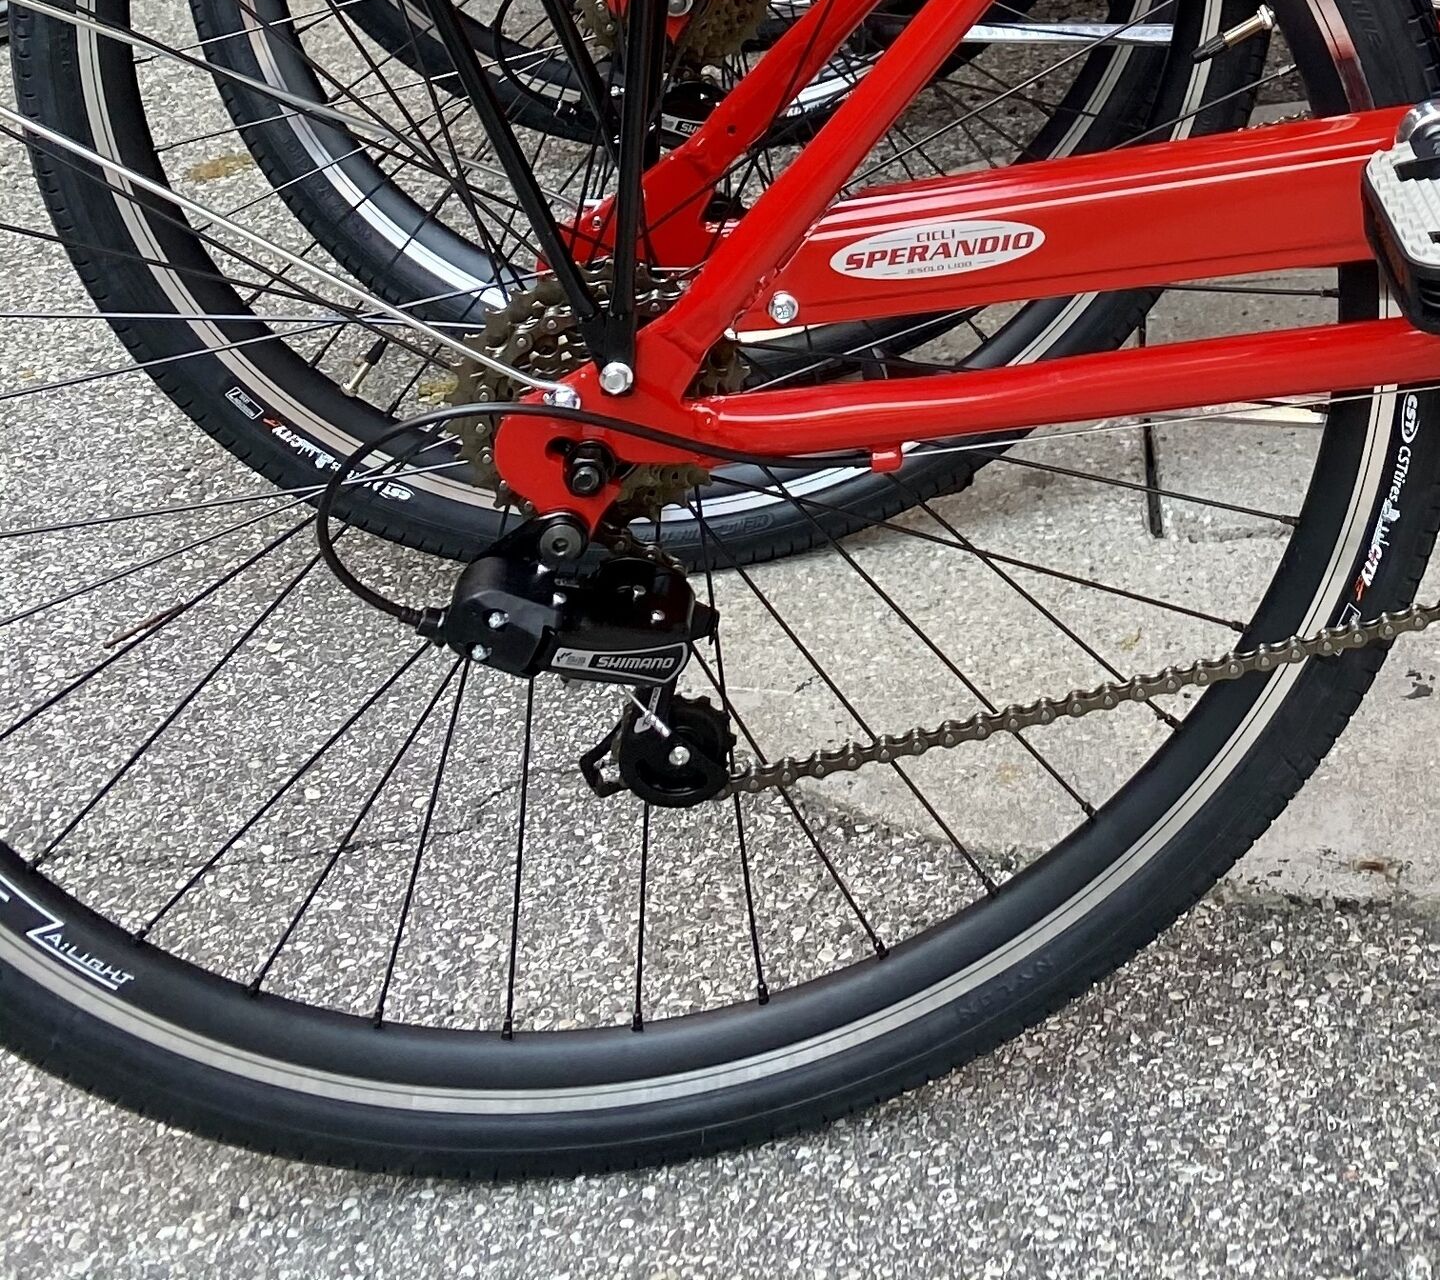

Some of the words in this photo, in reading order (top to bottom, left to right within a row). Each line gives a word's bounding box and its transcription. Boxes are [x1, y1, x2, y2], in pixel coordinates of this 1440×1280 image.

[916, 228, 956, 243] CICLI
[844, 231, 1035, 272] SPERANDIO
[596, 656, 675, 670] SHIMANO
